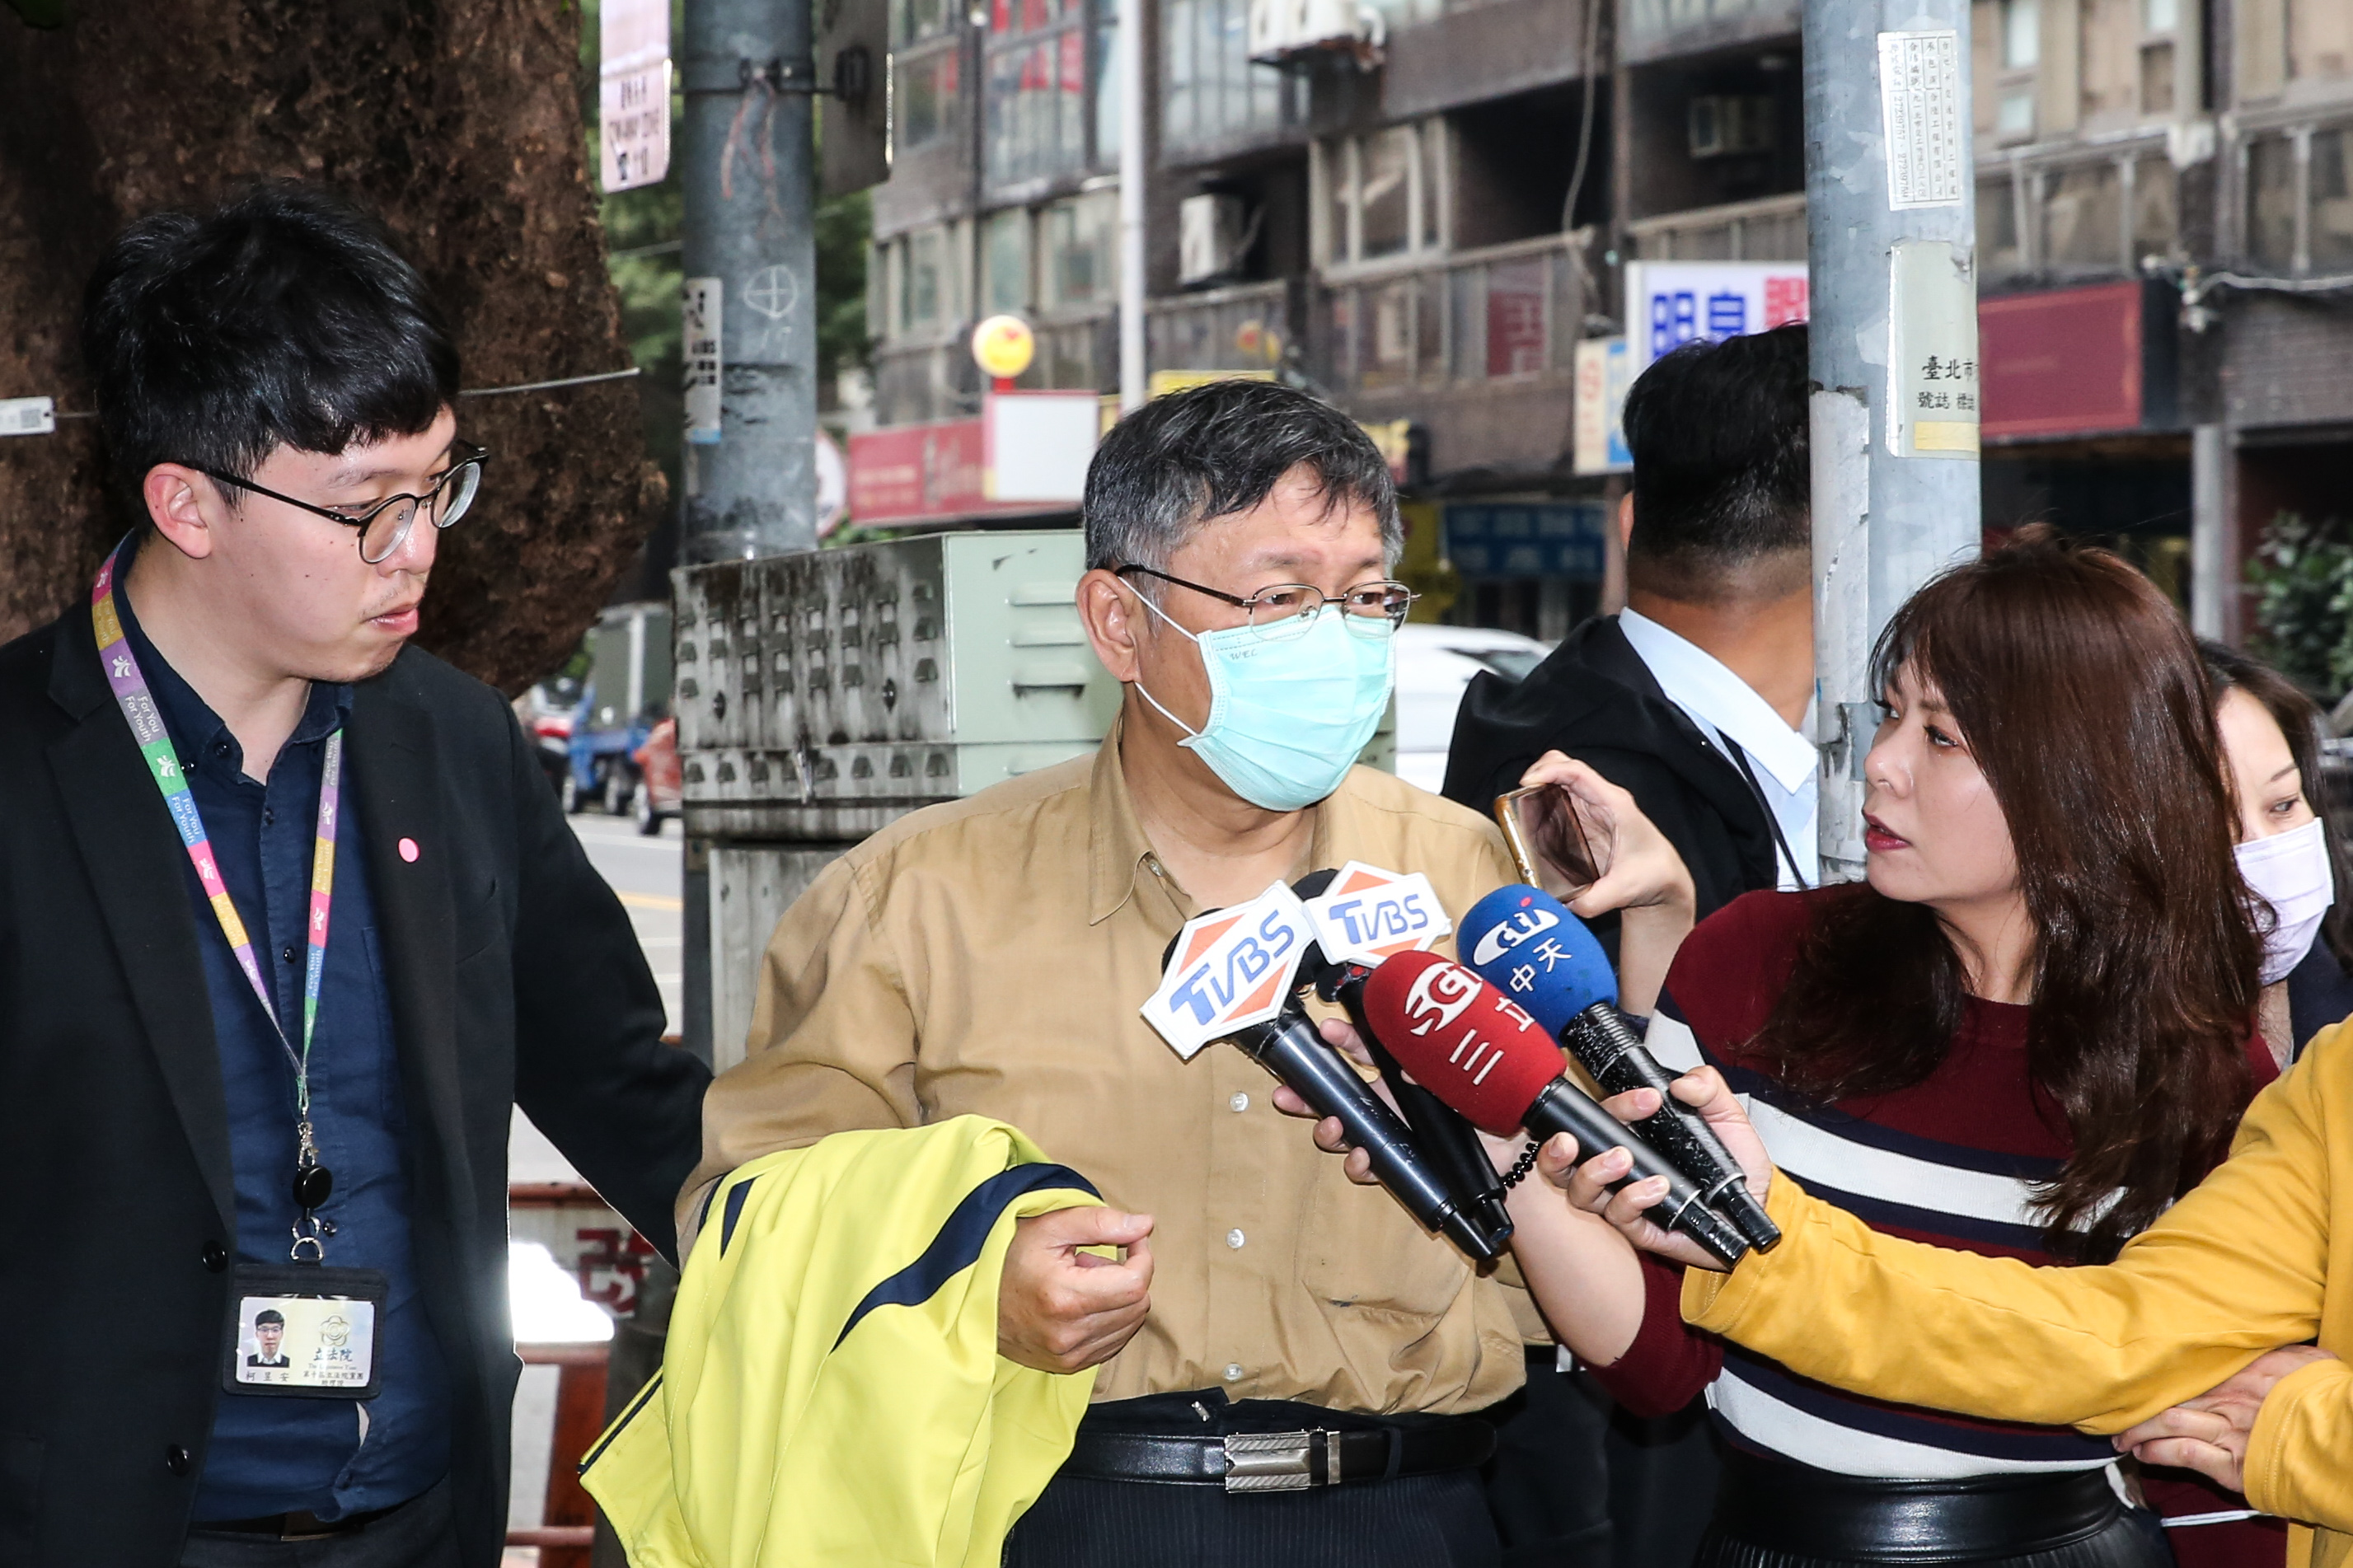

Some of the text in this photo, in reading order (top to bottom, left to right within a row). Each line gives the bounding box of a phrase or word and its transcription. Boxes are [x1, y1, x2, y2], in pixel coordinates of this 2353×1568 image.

[1917, 391, 1950, 410] 號誌
[124, 696, 152, 742] For Youth
[138, 696, 160, 733] For You
[171, 796, 195, 843] For Youth
[182, 798, 200, 835] For You
[1329, 893, 1429, 945] TVBS
[1169, 909, 1295, 1026] TVBS
[1509, 937, 1573, 993] 中天
[312, 1347, 353, 1362] 立法院
